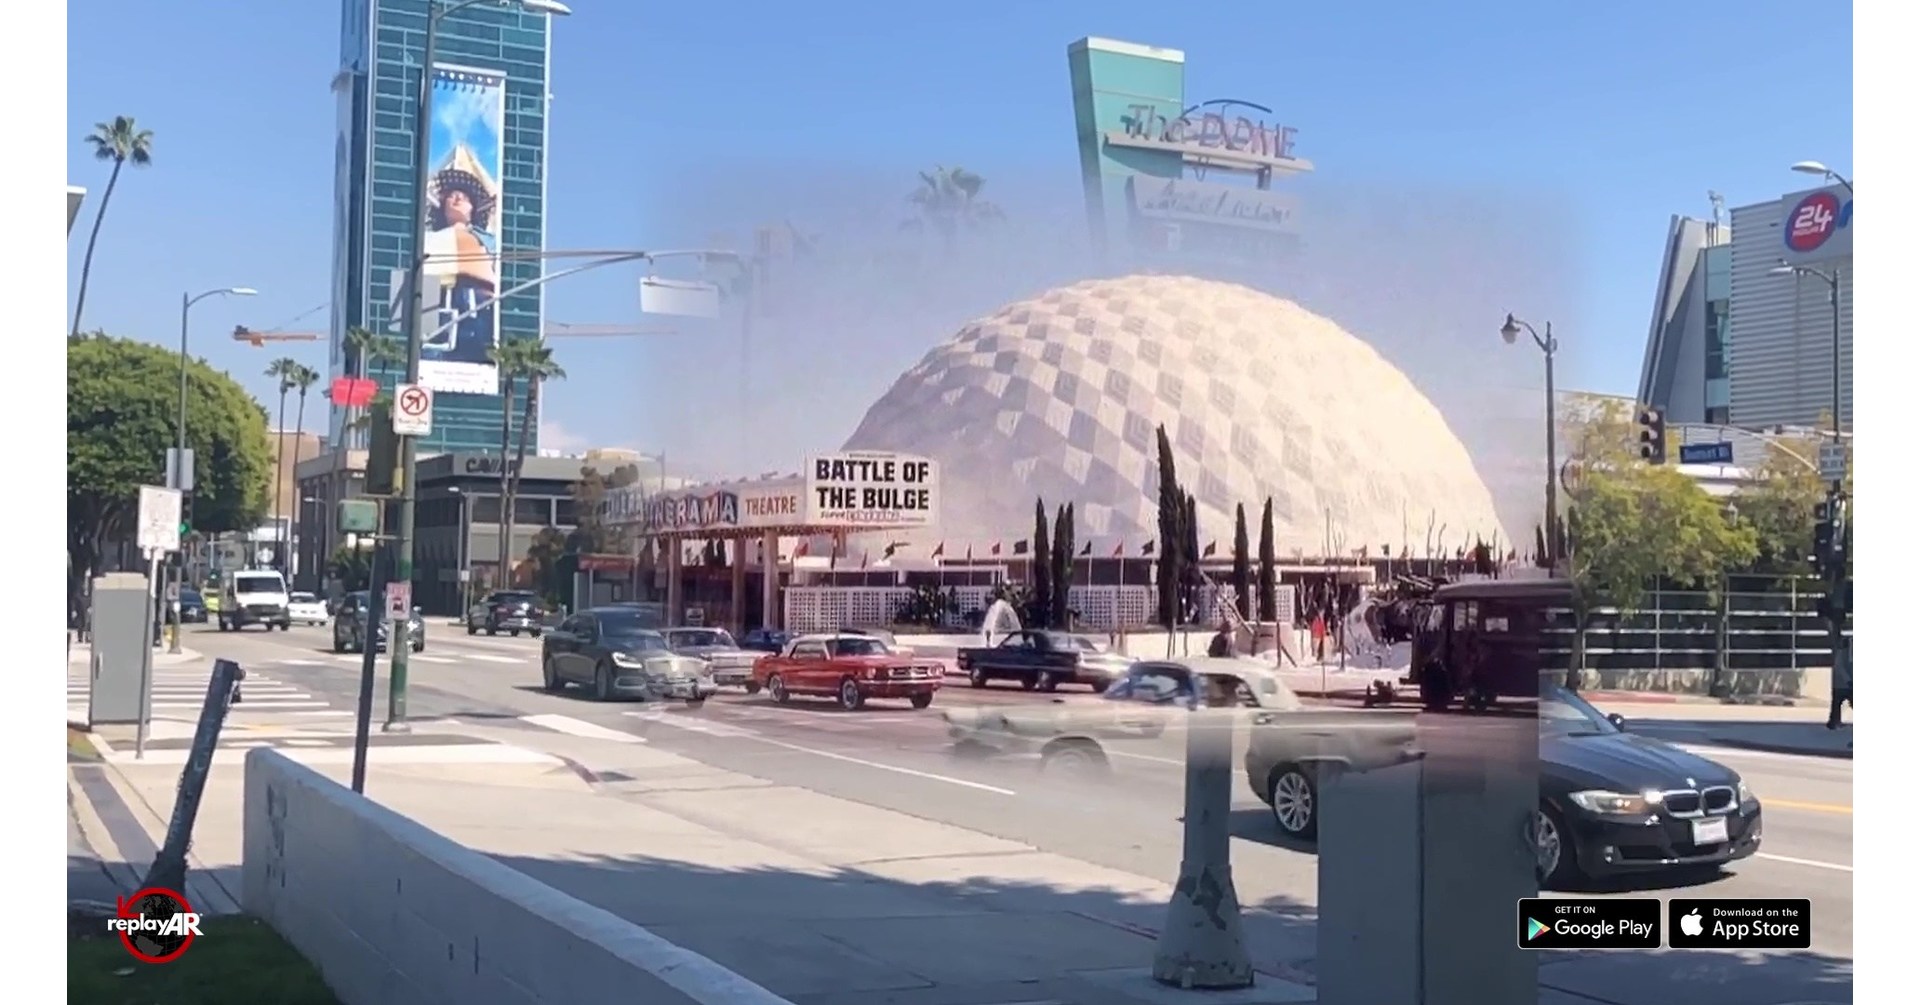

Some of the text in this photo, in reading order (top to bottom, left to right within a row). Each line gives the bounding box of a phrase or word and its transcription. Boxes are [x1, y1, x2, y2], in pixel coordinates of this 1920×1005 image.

[1795, 204, 1833, 232] 24
[816, 459, 929, 483] BATTLE OF
[745, 496, 797, 516] THEATRE
[816, 487, 929, 510] THE BULGE
